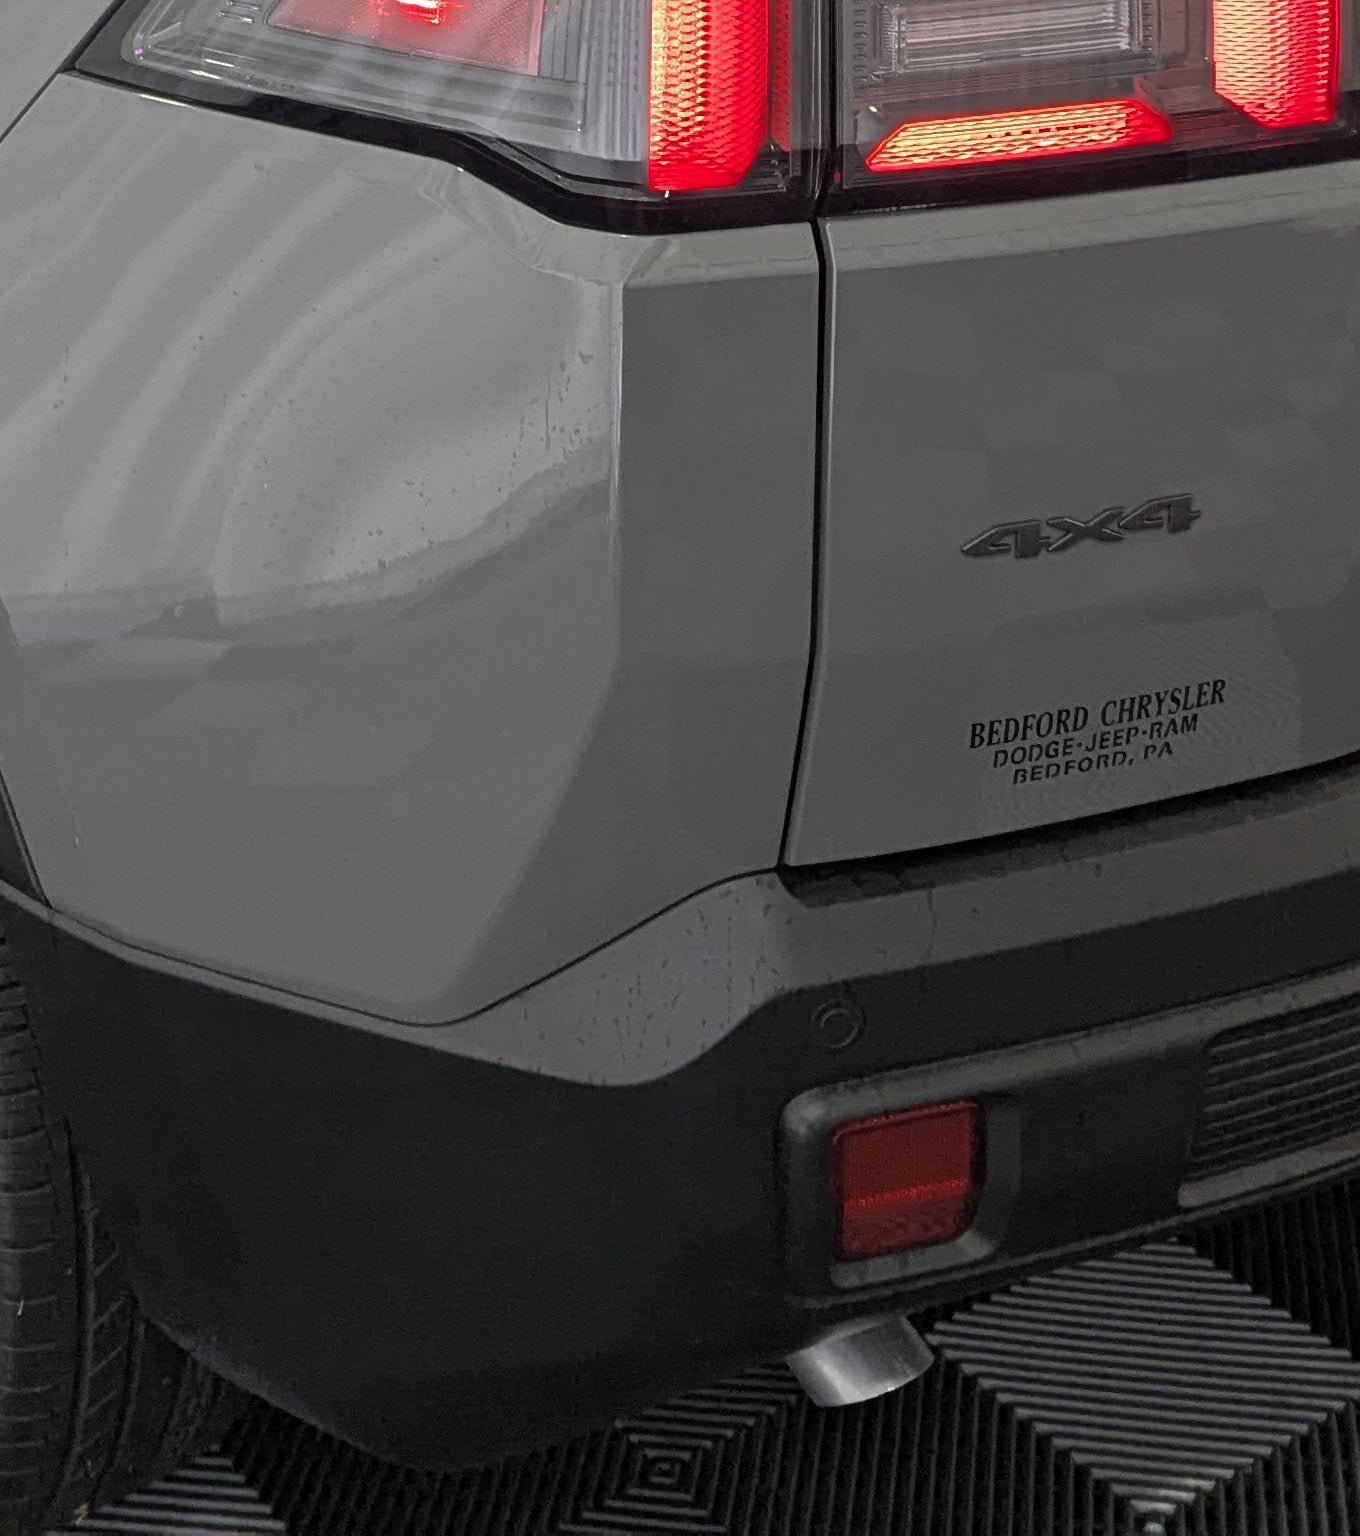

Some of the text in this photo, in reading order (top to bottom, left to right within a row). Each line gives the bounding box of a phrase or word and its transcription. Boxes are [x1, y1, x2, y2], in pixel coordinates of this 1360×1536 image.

[969, 678, 1227, 750] BEDFORD CHRYSLER
[1012, 741, 1174, 786] BEDFORD, PA
